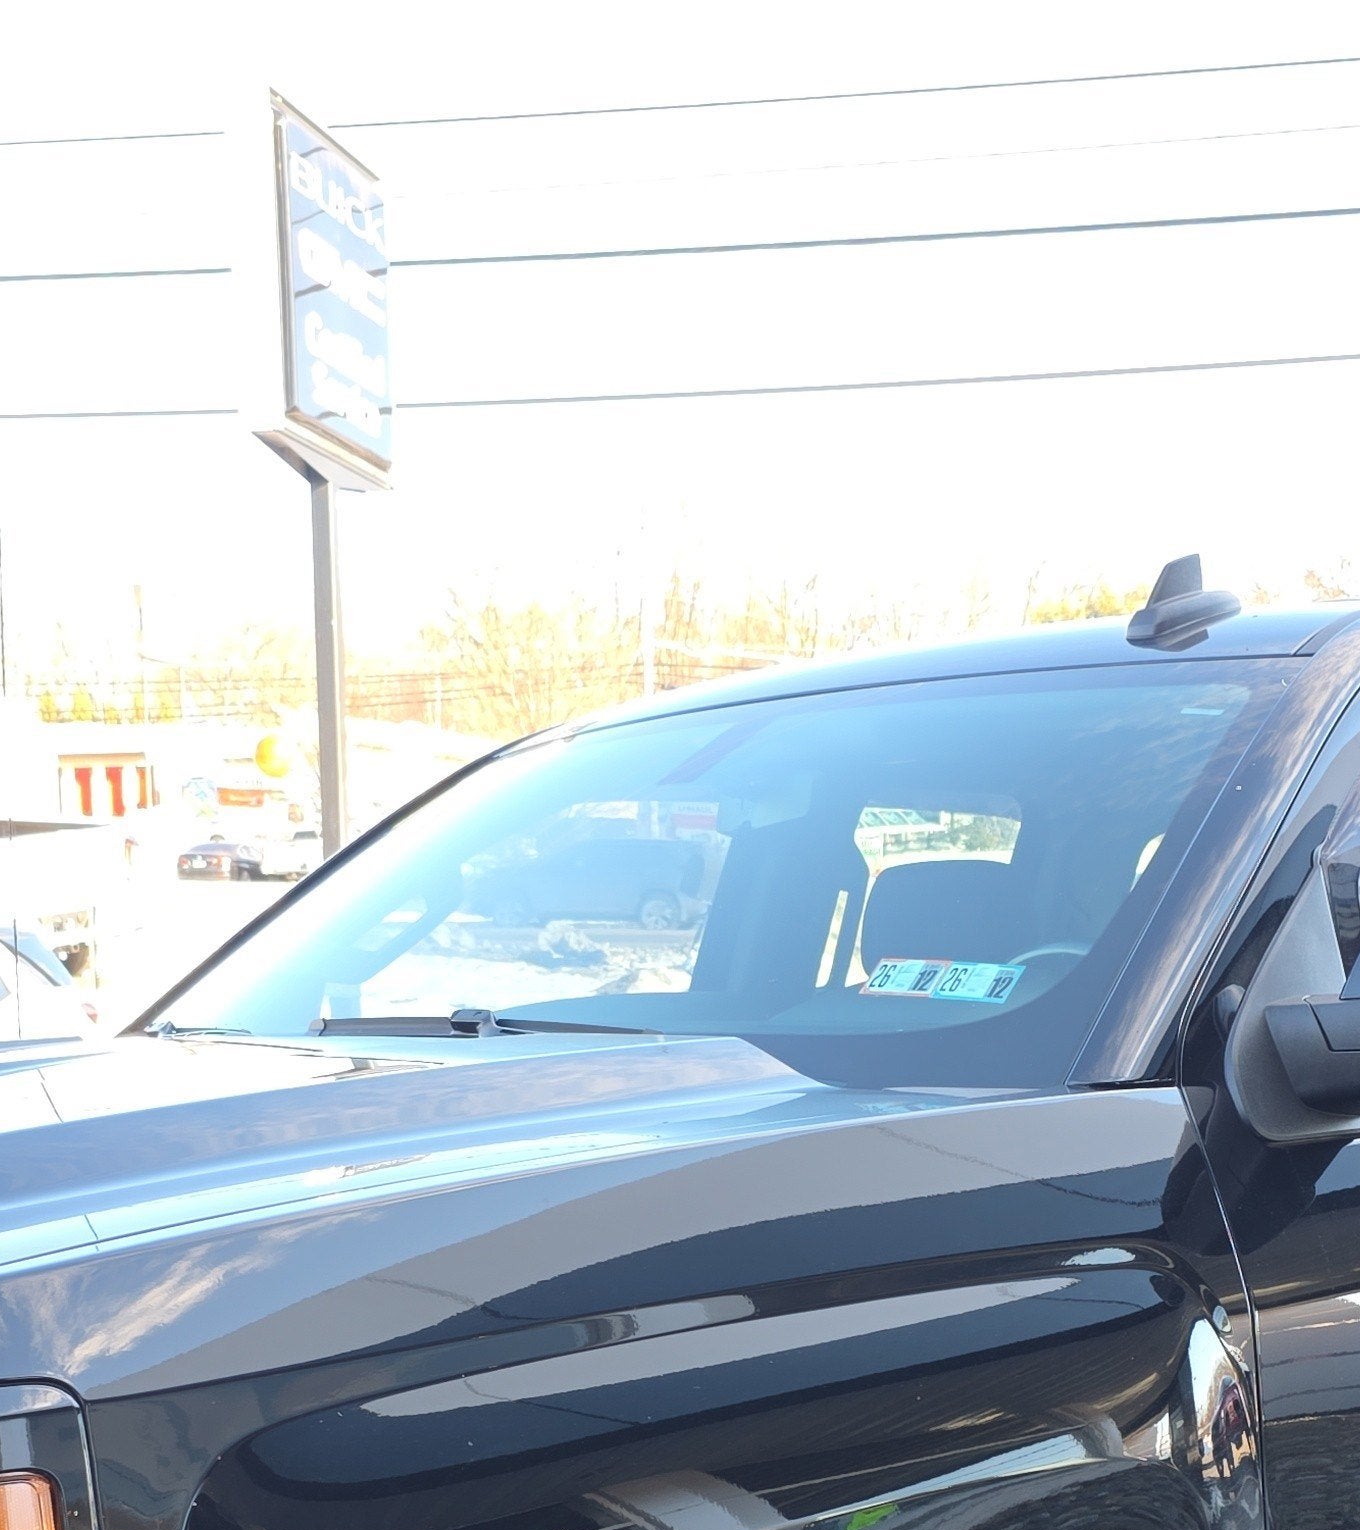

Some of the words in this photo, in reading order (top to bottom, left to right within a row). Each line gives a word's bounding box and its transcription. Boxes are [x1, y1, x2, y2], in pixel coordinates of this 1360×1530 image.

[289, 150, 386, 254] BUICK
[868, 964, 898, 988] 26
[911, 969, 938, 991] 12
[939, 967, 969, 992] 26
[986, 976, 1014, 999] 12
